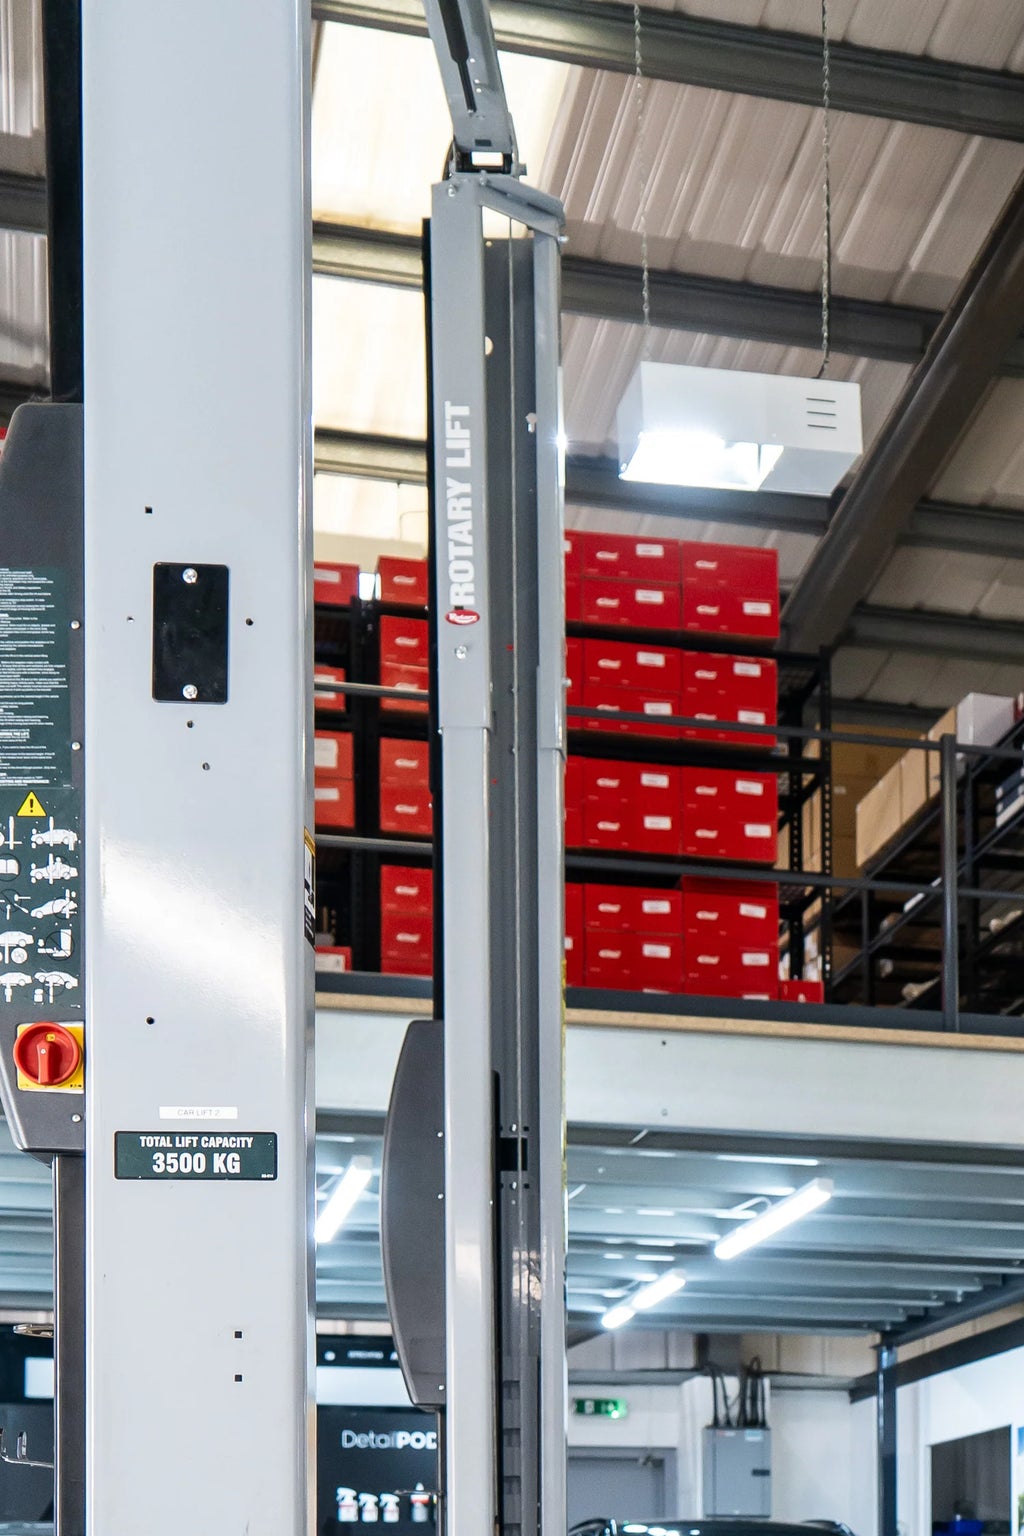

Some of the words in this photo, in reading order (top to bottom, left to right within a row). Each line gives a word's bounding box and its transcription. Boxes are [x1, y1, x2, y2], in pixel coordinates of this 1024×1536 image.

[444, 401, 471, 468] LIFT
[446, 477, 475, 606] ROTARY
[177, 1108, 194, 1117] CAR
[196, 1108, 213, 1117] LIFT
[139, 1136, 173, 1148] TOTAL
[175, 1136, 199, 1148] LIFT
[200, 1136, 254, 1148] CAPACITY
[152, 1152, 206, 1173] 3500
[213, 1152, 241, 1173] KG
